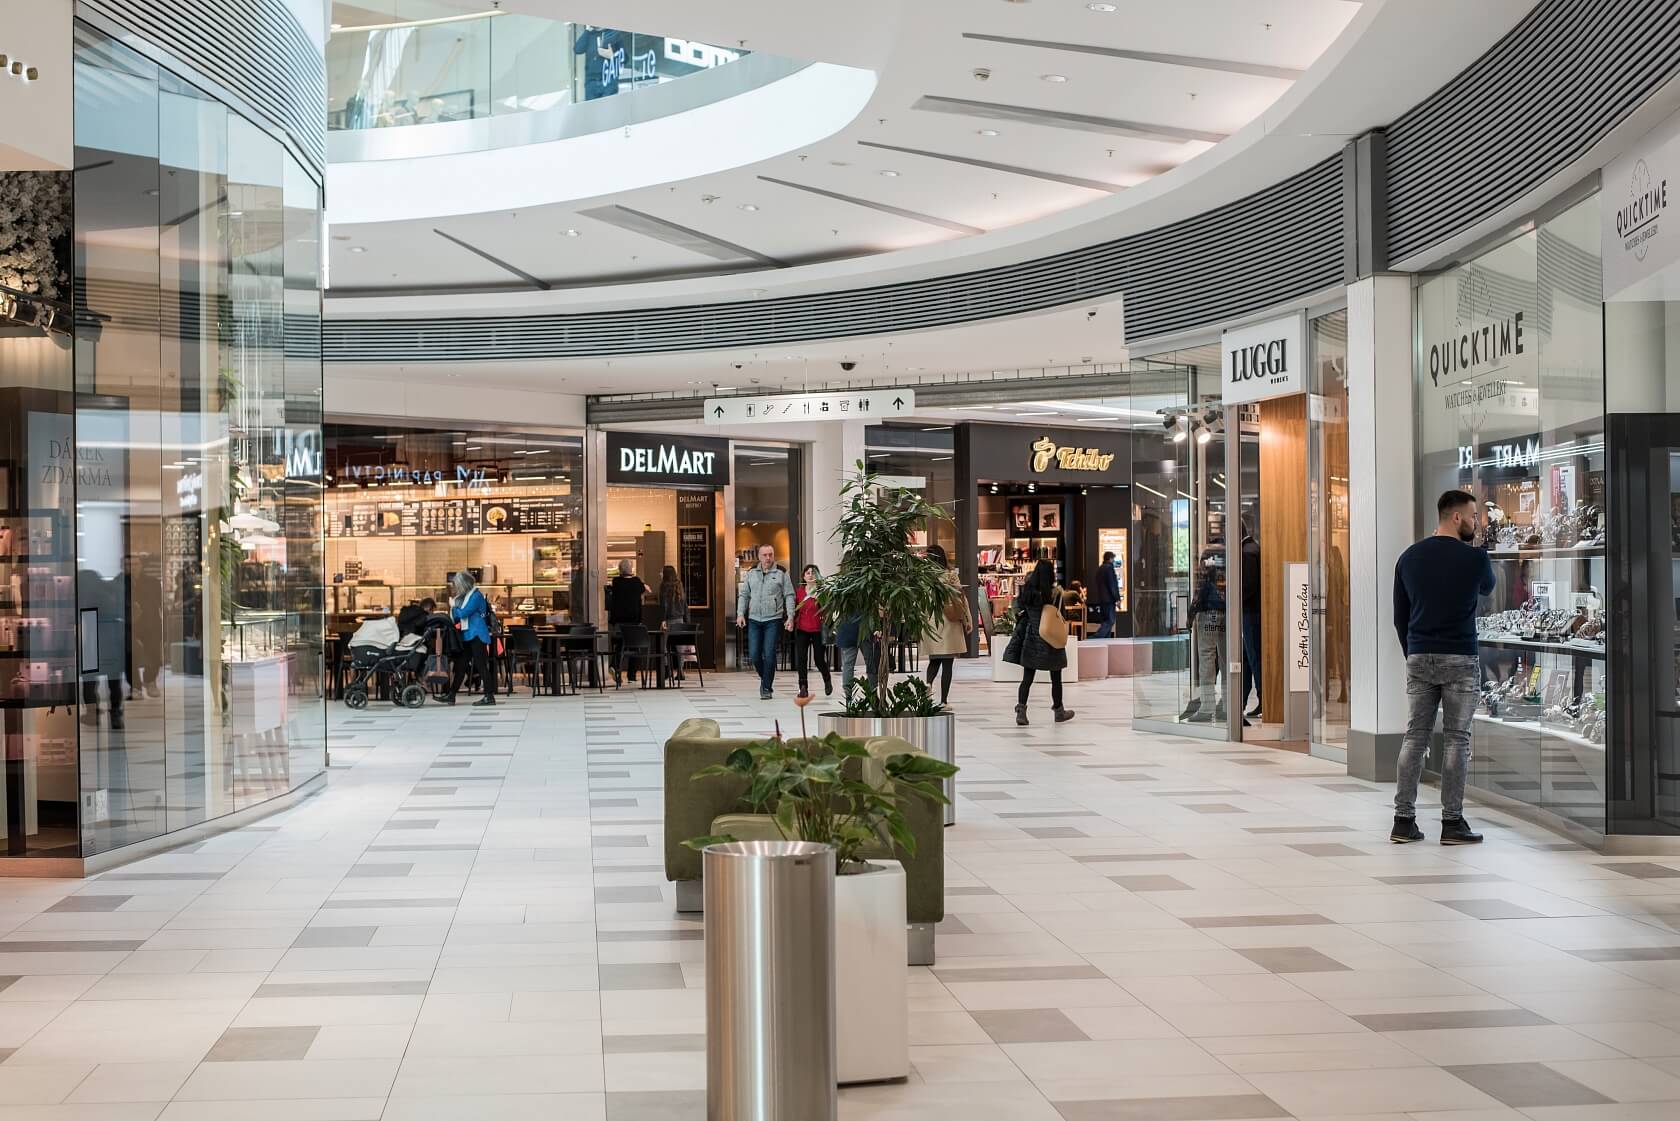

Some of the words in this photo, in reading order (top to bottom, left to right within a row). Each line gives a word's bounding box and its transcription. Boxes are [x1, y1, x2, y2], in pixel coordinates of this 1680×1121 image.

[1617, 180, 1666, 238] QUICKTIME
[1231, 338, 1288, 383] LUGGI
[1430, 312, 1523, 387] QUICKTIME
[1445, 389, 1472, 409] WATCHES
[41, 464, 112, 487] ZDARMA
[620, 444, 715, 474] DELMART
[1056, 447, 1114, 471] Tchibo
[1297, 583, 1309, 632] Barclay
[1298, 635, 1309, 669] Betty
